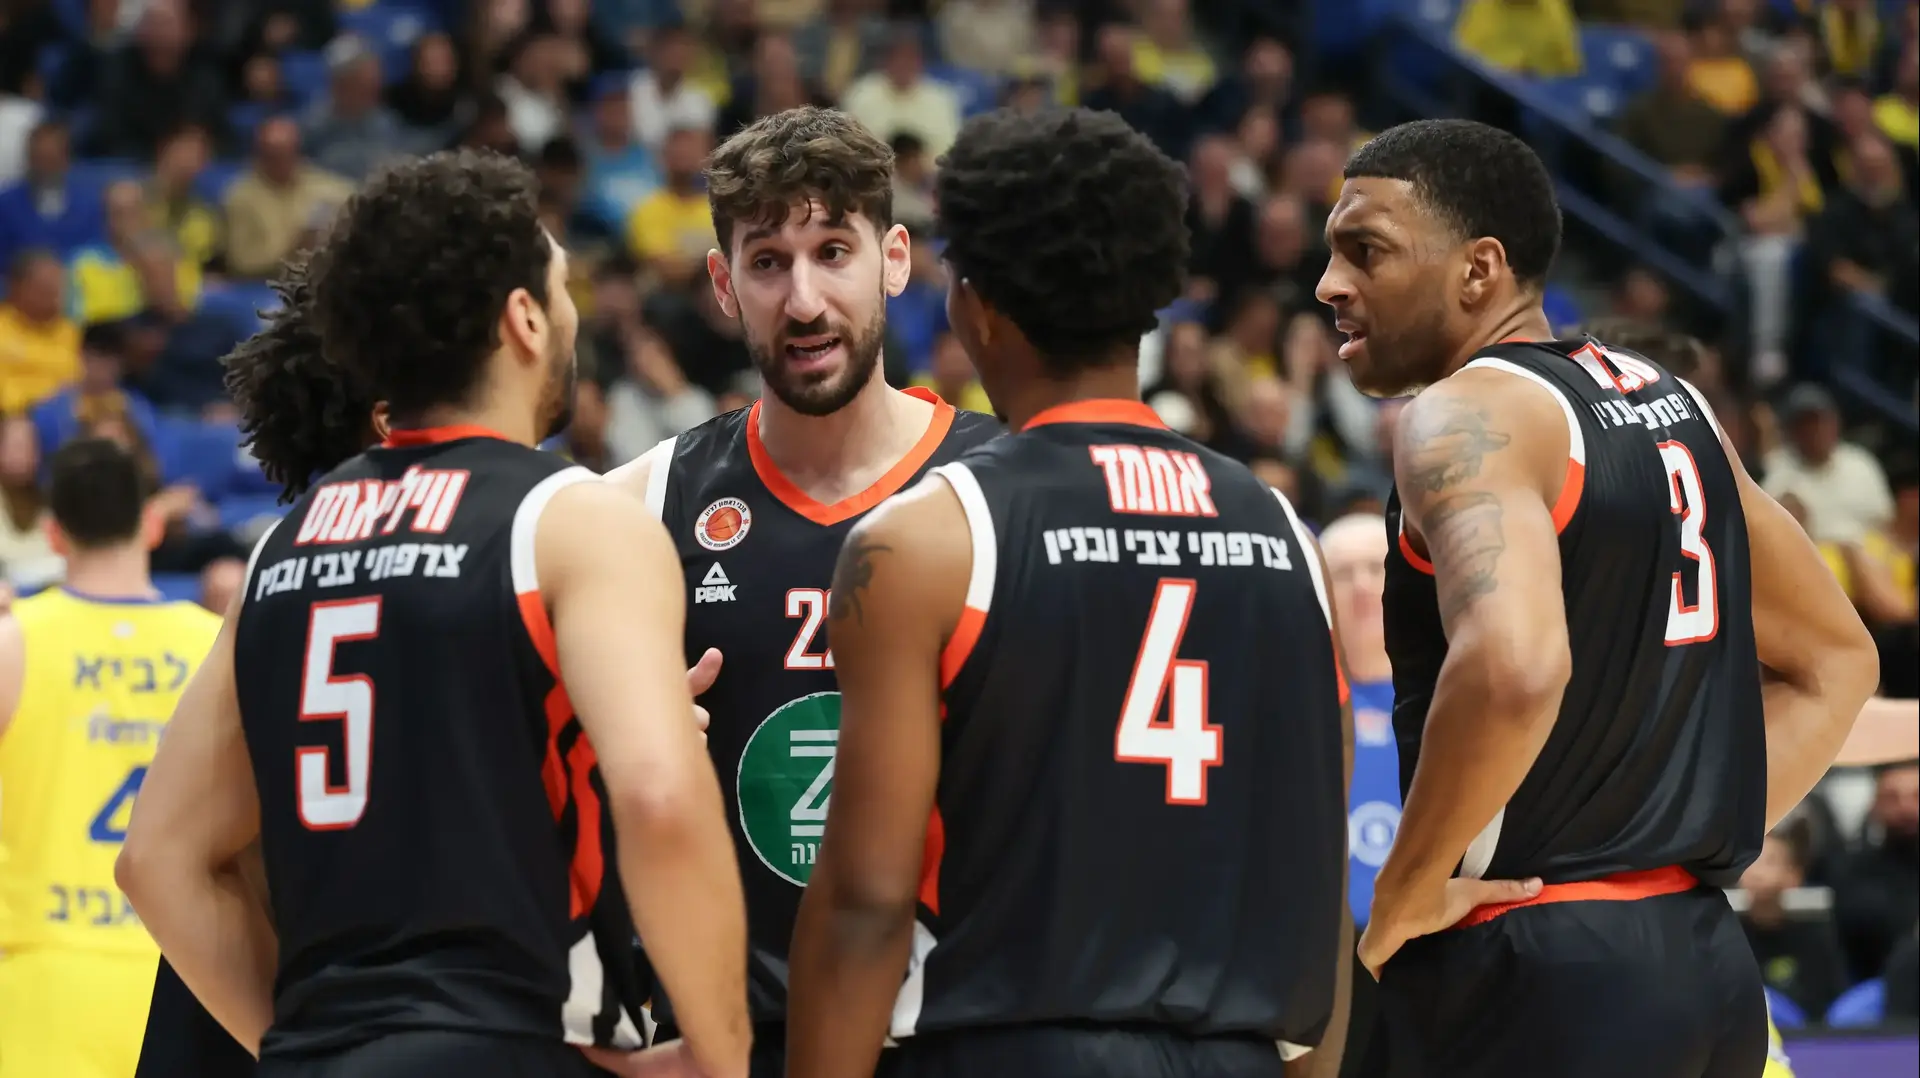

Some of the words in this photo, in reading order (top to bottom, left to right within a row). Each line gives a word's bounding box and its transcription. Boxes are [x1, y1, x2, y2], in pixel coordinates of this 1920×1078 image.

[1088, 444, 1219, 517] אחמד
[293, 464, 471, 546] וויליאמס
[364, 542, 469, 581] צרפתי
[1043, 527, 1119, 565] ובנין
[1125, 529, 1181, 565] צבי
[1188, 532, 1293, 571] צרפתי
[1656, 439, 1719, 646] 3
[254, 555, 309, 602] ובנין
[310, 549, 362, 588] צבי
[695, 584, 738, 604] PEAK
[784, 587, 835, 670] 2
[74, 651, 188, 693] לביא
[1114, 577, 1224, 806] 4
[295, 595, 383, 831] 5
